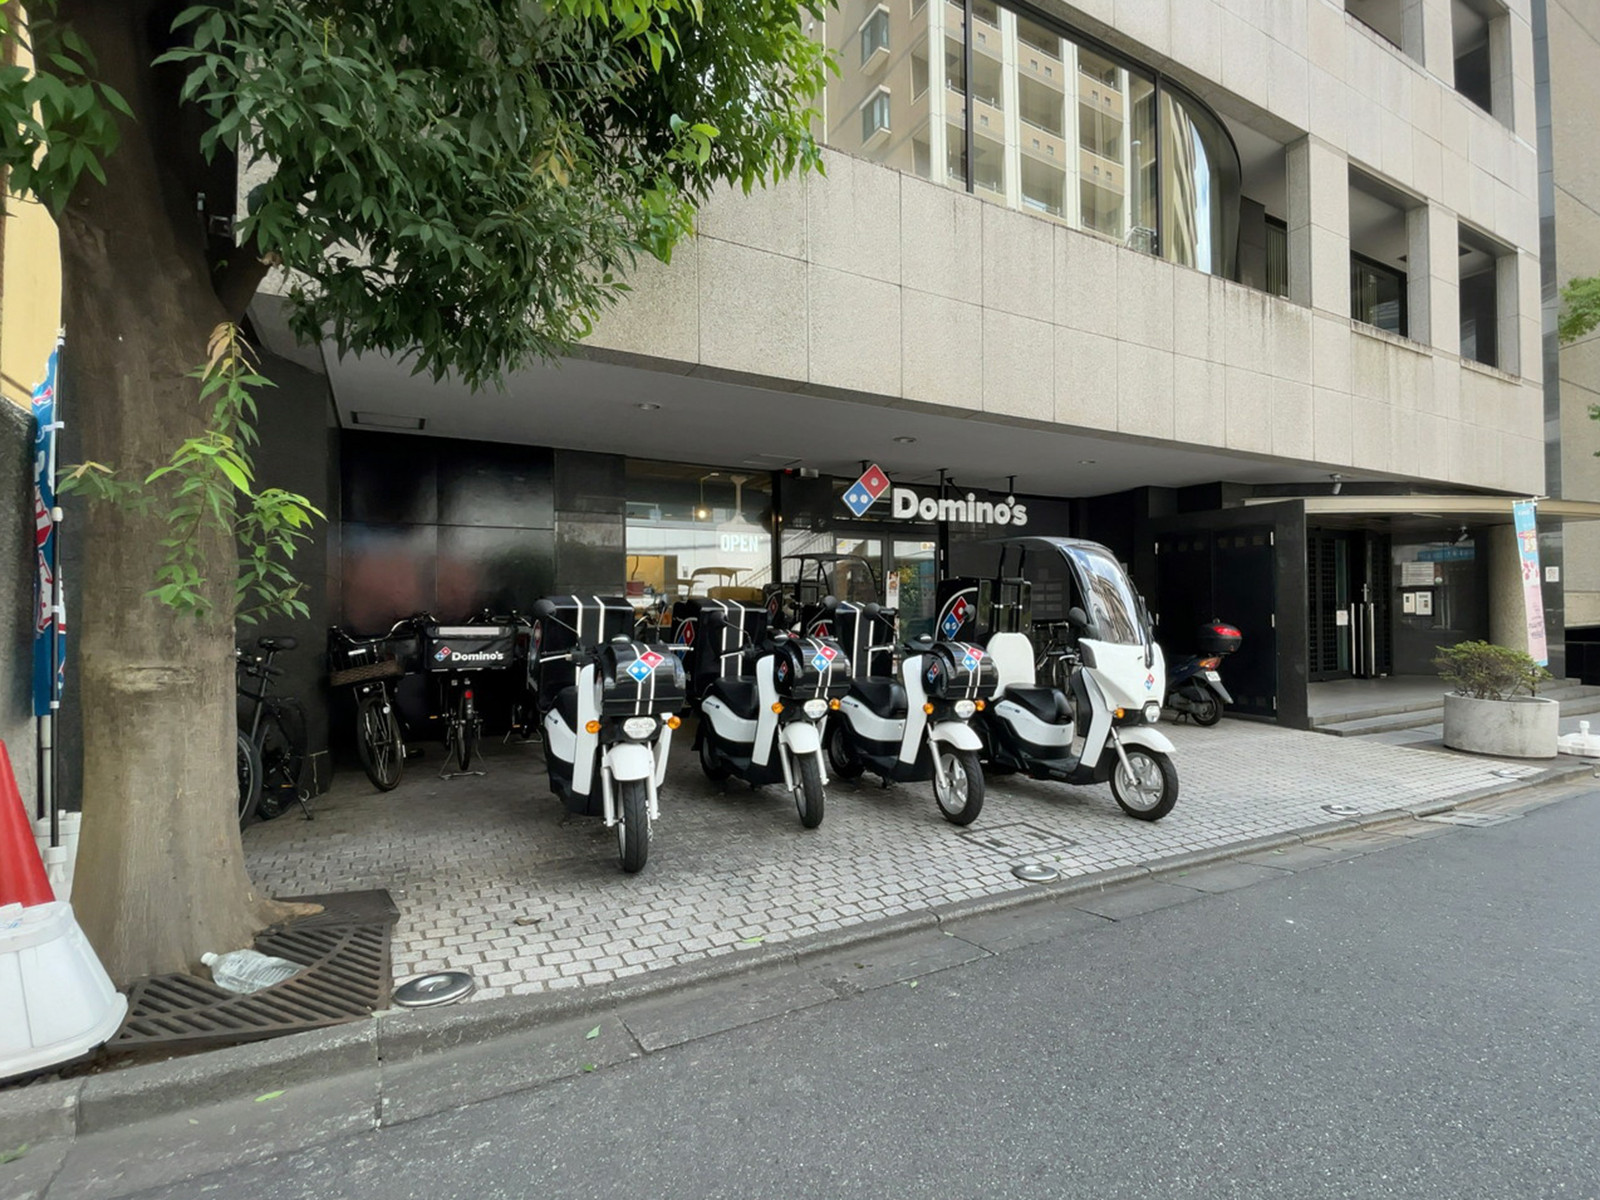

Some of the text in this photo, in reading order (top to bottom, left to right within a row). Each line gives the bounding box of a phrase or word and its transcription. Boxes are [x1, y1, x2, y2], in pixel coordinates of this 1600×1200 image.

[892, 487, 1028, 526] Domino's
[720, 534, 758, 552] OPEN
[451, 651, 504, 661] Domino's
